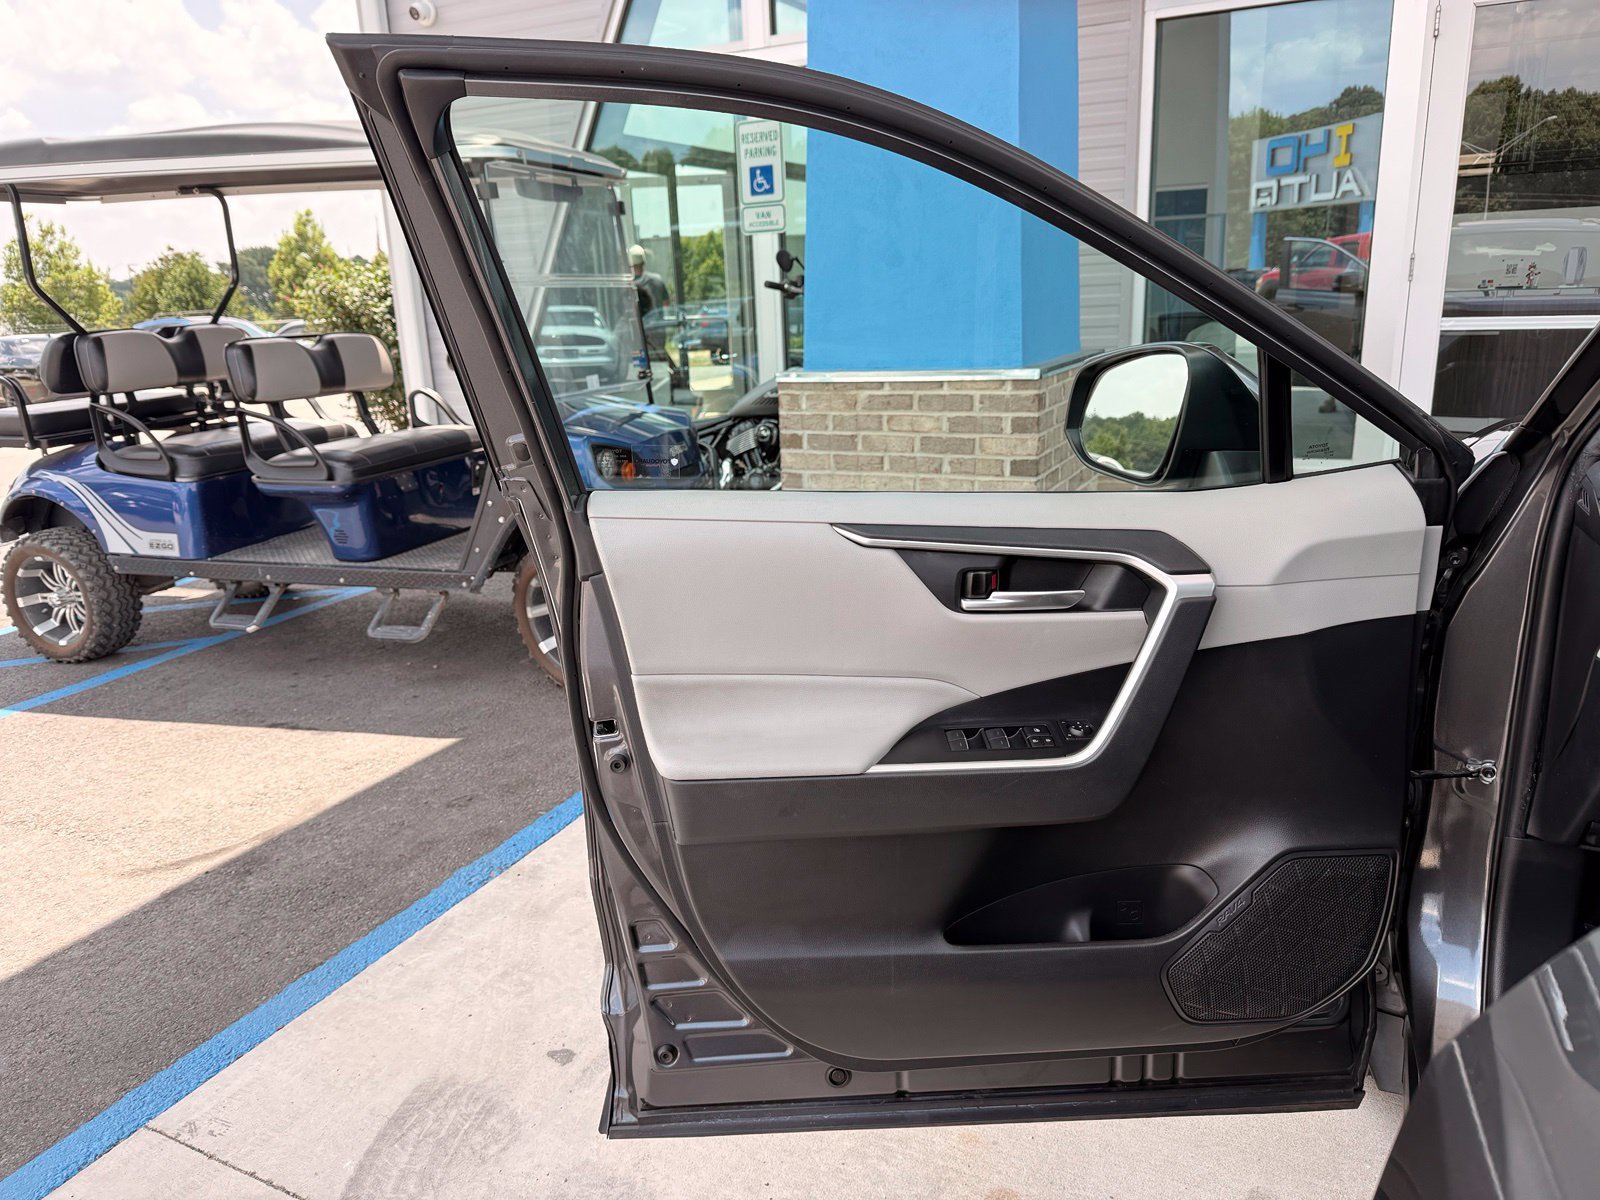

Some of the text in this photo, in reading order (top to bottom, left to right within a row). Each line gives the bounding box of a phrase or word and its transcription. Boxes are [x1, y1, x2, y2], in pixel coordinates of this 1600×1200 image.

[741, 129, 778, 145] RESERVED
[744, 145, 777, 159] PARKING
[755, 210, 772, 219] VAN
